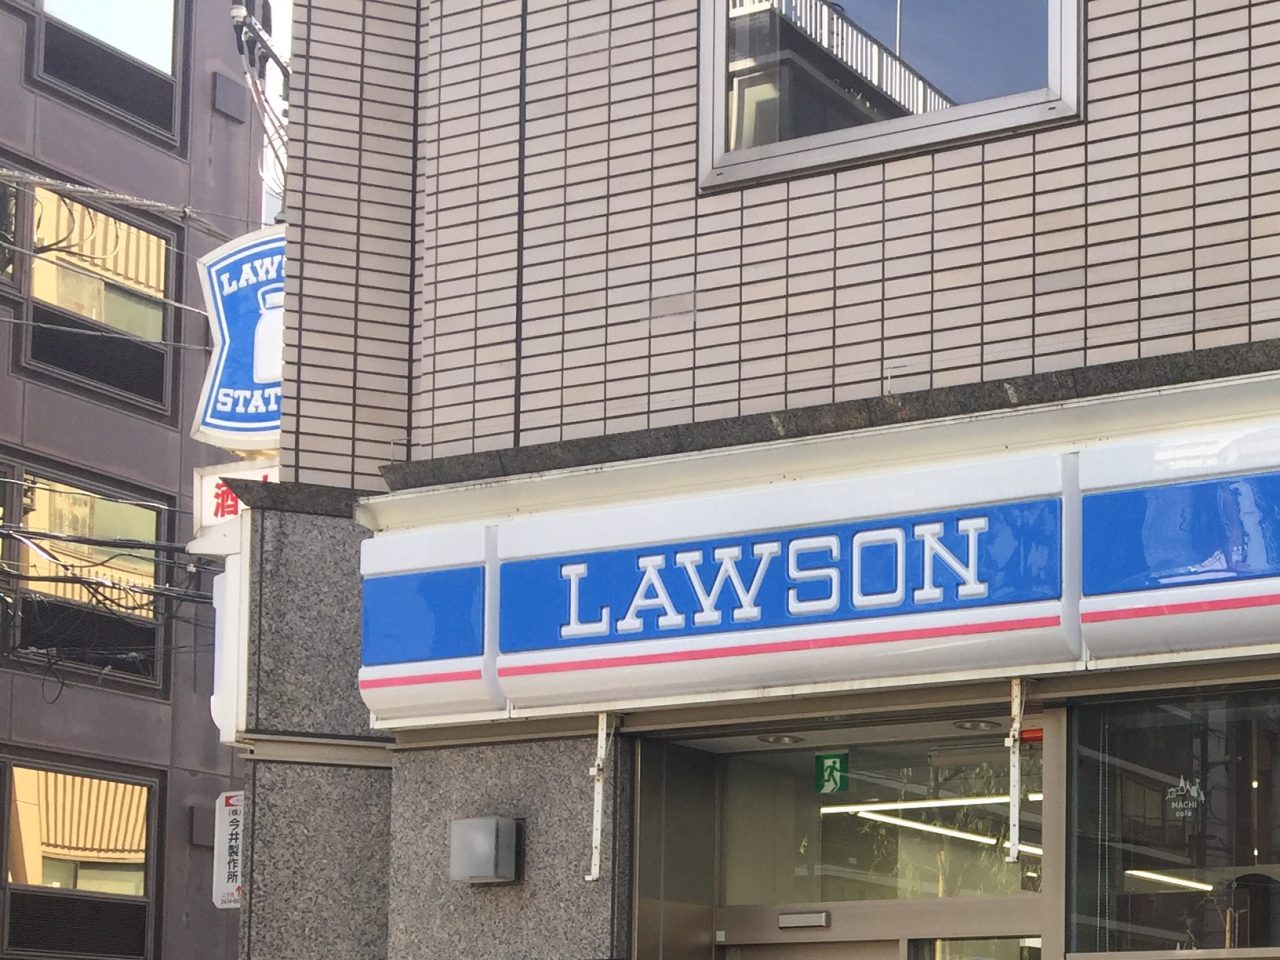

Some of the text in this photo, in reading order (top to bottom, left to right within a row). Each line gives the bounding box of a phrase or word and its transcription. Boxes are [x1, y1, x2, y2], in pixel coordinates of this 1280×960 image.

[559, 516, 990, 640] LAWSON
[1171, 801, 1198, 809] MACHI
[226, 817, 241, 884] 今井製作所
